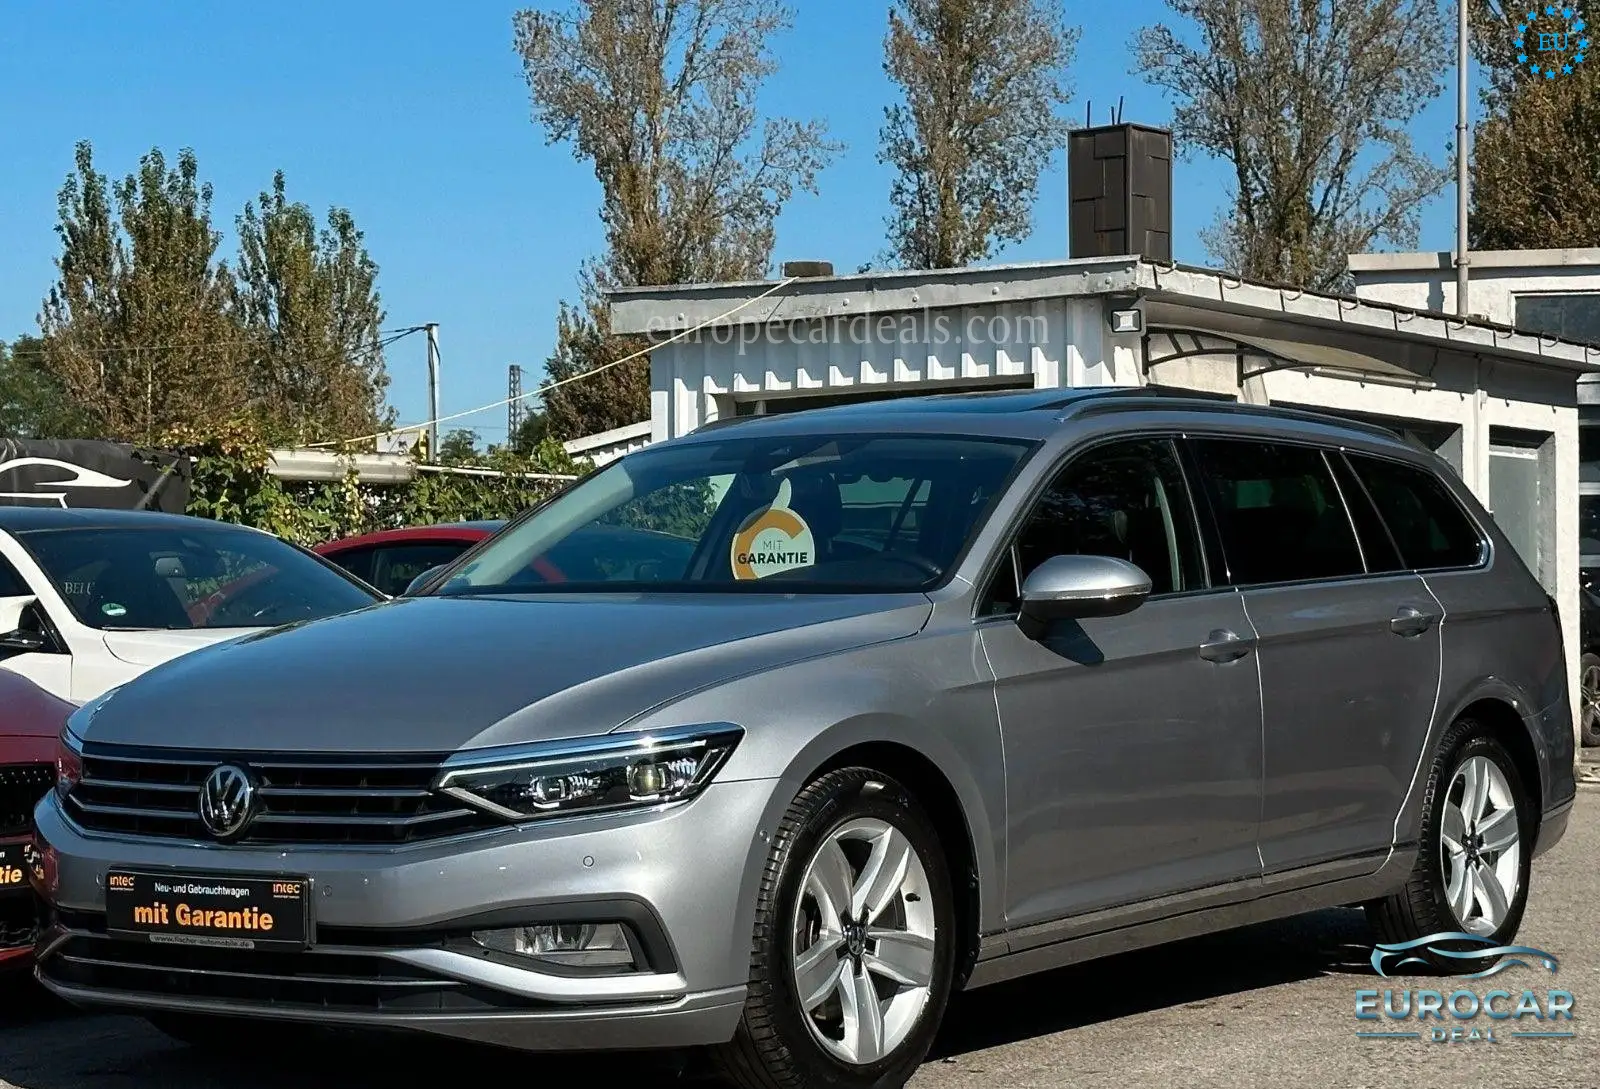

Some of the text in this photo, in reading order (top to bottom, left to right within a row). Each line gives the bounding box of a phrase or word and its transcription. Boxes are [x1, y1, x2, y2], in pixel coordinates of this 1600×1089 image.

[763, 540, 783, 551] MIT
[737, 552, 808, 565] GARANTIE
[154, 882, 250, 898] Neu- und Gebrauchtwagen
[134, 901, 273, 930] mit Garantie
